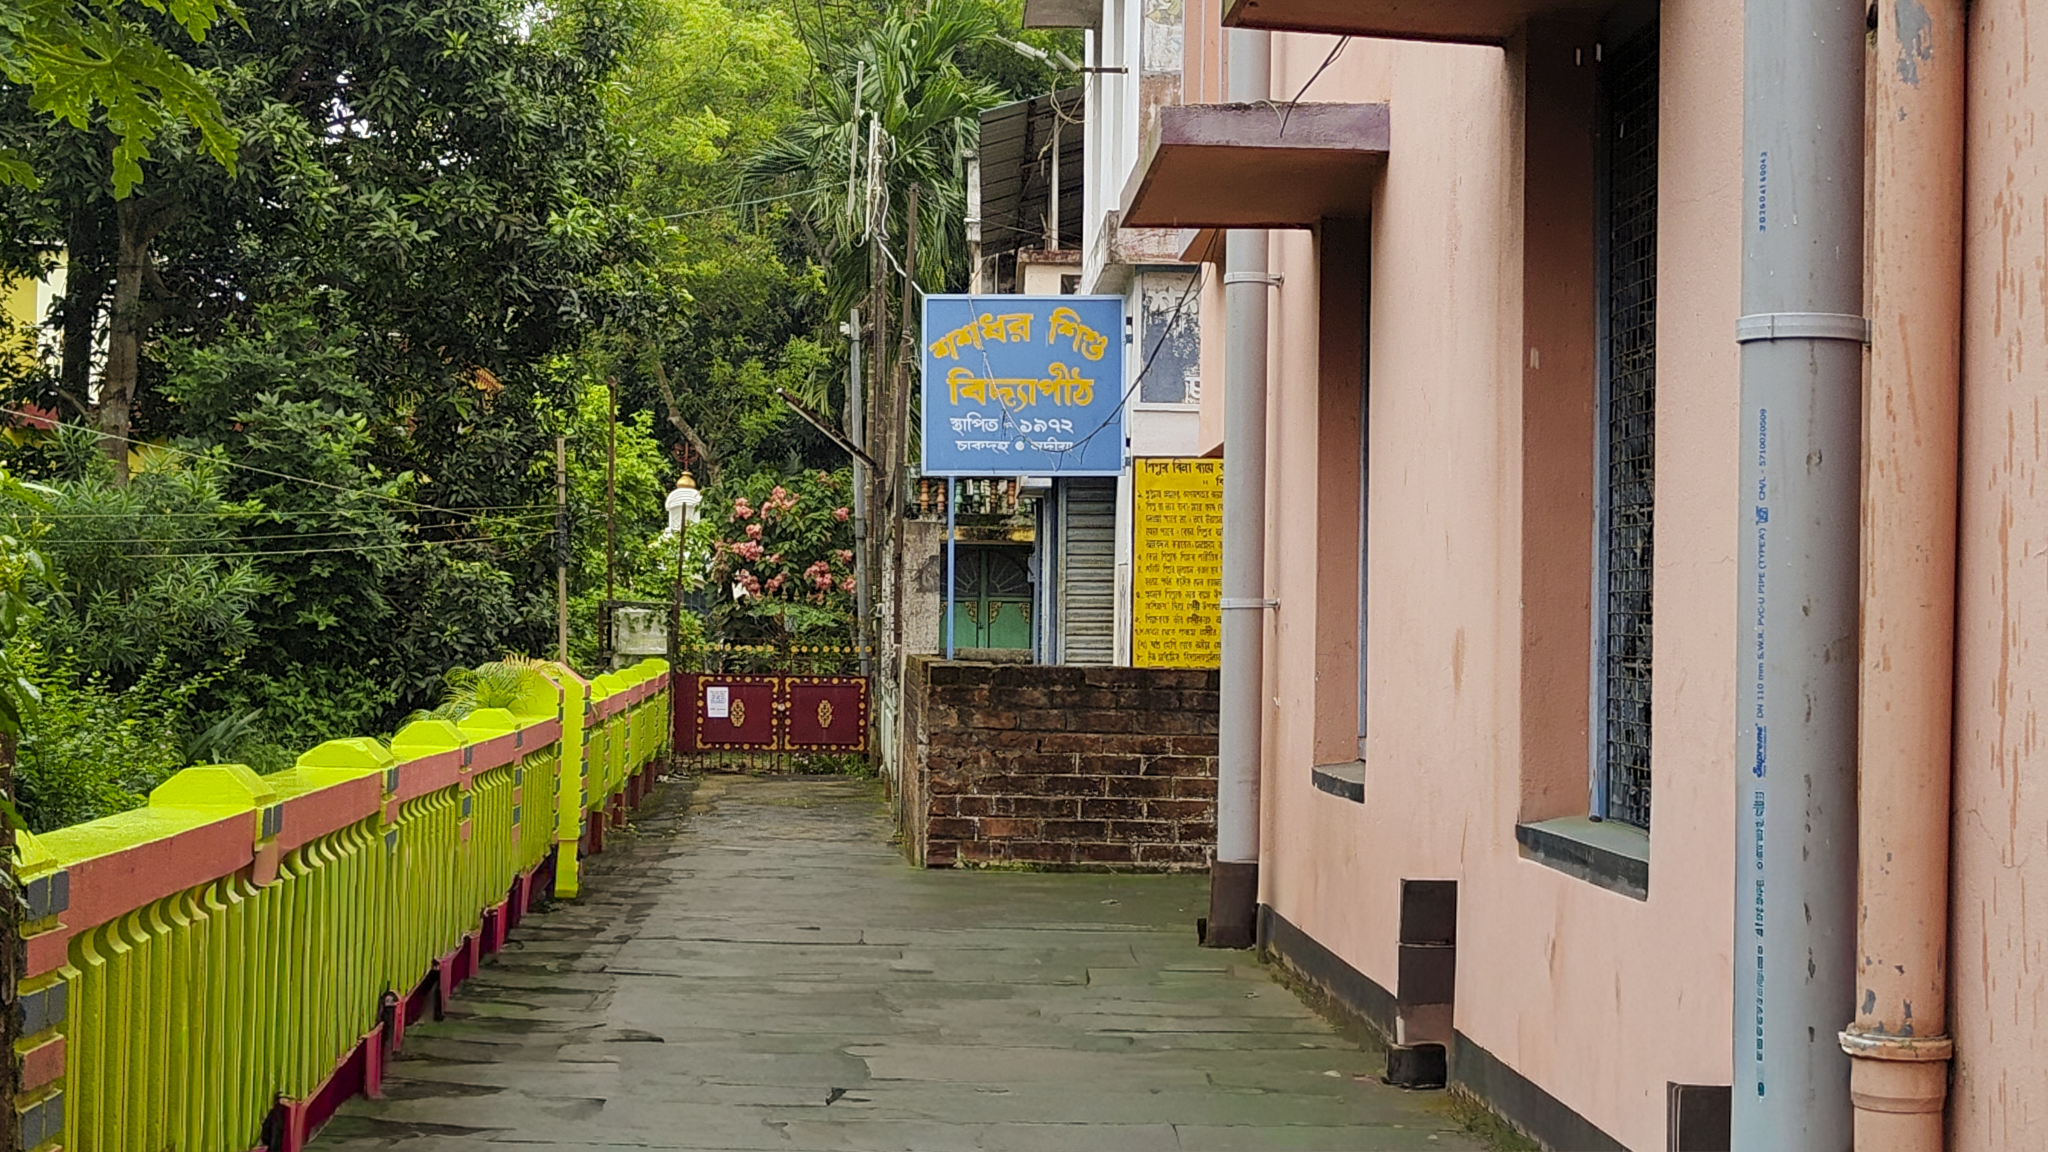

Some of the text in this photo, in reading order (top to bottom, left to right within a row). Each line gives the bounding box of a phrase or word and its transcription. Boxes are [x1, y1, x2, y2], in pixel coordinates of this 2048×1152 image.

[1048, 306, 1109, 361] শিশু
[946, 361, 1095, 413] বিদ্যাপীঠ
[949, 411, 1074, 437] স্থাপিত ১৯৭২
[955, 440, 1010, 455] চাকদহ
[1758, 408, 1767, 467] 5710020509
[1758, 476, 1767, 501] CM/L
[1757, 572, 1765, 594] PIPE
[1757, 629, 1765, 660] S.W.R.
[1757, 662, 1764, 681] mm
[1756, 683, 1764, 700] 110
[1756, 704, 1764, 719] DN
[1752, 725, 1764, 778] Supreme
